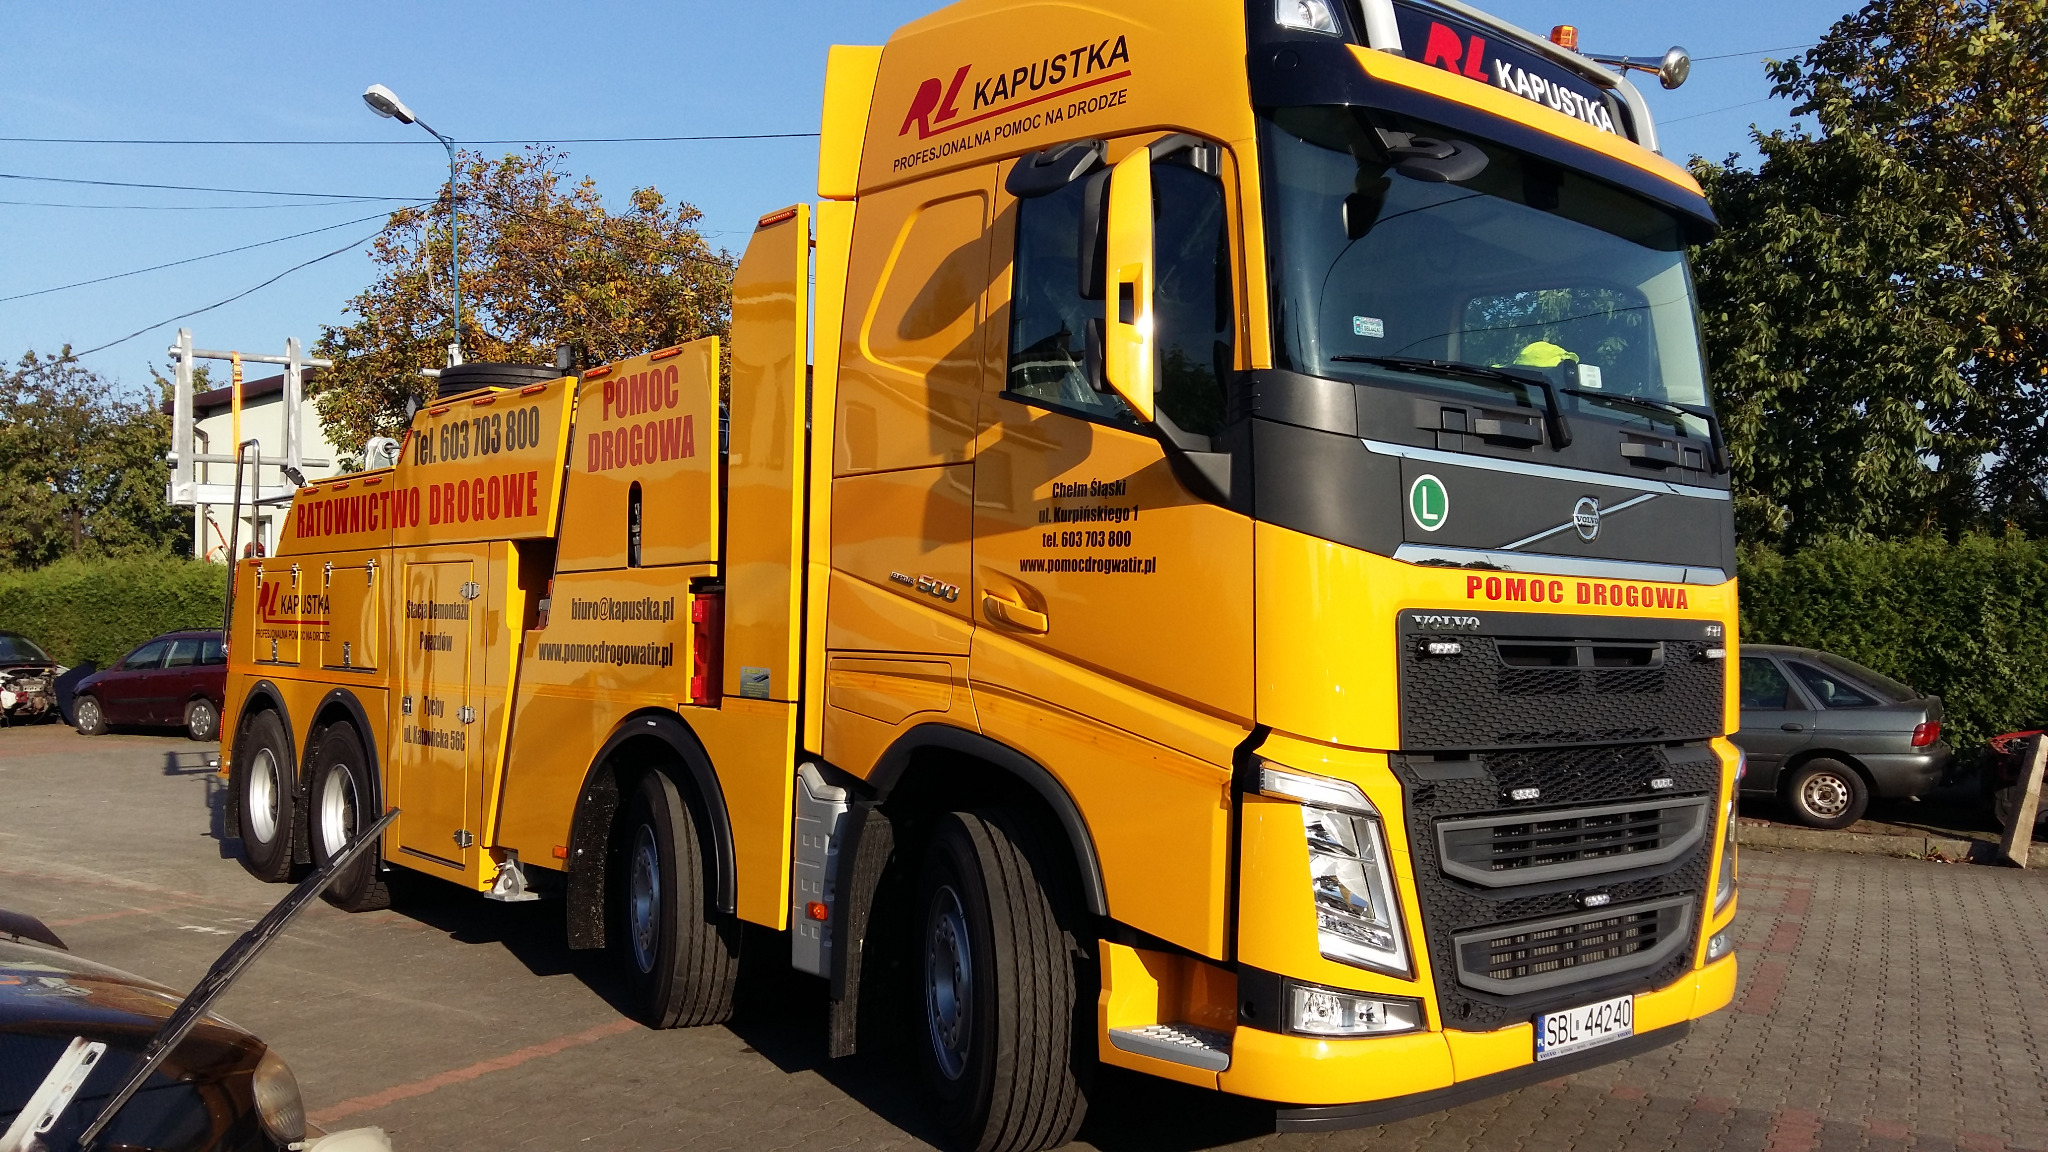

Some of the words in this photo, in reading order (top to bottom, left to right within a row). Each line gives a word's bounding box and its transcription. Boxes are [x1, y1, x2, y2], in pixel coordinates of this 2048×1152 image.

[1424, 22, 1489, 82] RL
[972, 34, 1129, 110] KAPUSTKA
[898, 63, 973, 140] RL
[1495, 59, 1614, 133] KAPUSTKA
[893, 129, 991, 172] PROFESJONALNA
[994, 114, 1041, 142] POMOC
[1044, 109, 1063, 126] NA
[1067, 88, 1127, 119] DRODZE
[603, 364, 680, 421] POMOC
[413, 428, 437, 466] Tel.
[440, 419, 470, 461] 603
[472, 415, 501, 457] 703
[505, 406, 540, 450] 800
[587, 415, 696, 473] DROGOWA
[1052, 482, 1088, 499] Chełm
[1090, 478, 1127, 500] Śląski
[1422, 486, 1438, 520] L
[296, 485, 421, 539] RATOWNICTWO
[429, 470, 539, 526] DROGOWE
[1038, 508, 1052, 524] ul.
[1053, 505, 1130, 525] Kurpińskiego
[1133, 504, 1139, 521] 1
[1575, 514, 1599, 525] VOLVO
[1042, 532, 1059, 548] tel.
[1061, 531, 1083, 548] 603
[1085, 531, 1106, 547] 703
[1108, 530, 1132, 547] 800
[1019, 556, 1157, 575] www.pomocdrogwatir.pl
[256, 581, 280, 624] RL
[917, 574, 960, 603] 500
[1466, 575, 1564, 604] POMOC
[1576, 582, 1689, 610] DROGOWA
[280, 594, 330, 615] KAPUSTKA
[407, 599, 428, 620] Stacja
[428, 599, 469, 621] Demontażu
[571, 596, 675, 623] biuro@kapustka.pl
[1412, 615, 1480, 630] VOLVO
[419, 631, 453, 652] Pojazdów
[538, 641, 673, 668] www.pomocdrogowatir.pl
[423, 695, 445, 718] Tychy
[403, 724, 412, 744] ul.
[412, 725, 449, 749] Katowicka
[1547, 1013, 1578, 1046] SBL
[1585, 1000, 1631, 1036] 44240
[1537, 1038, 1545, 1048] PL
